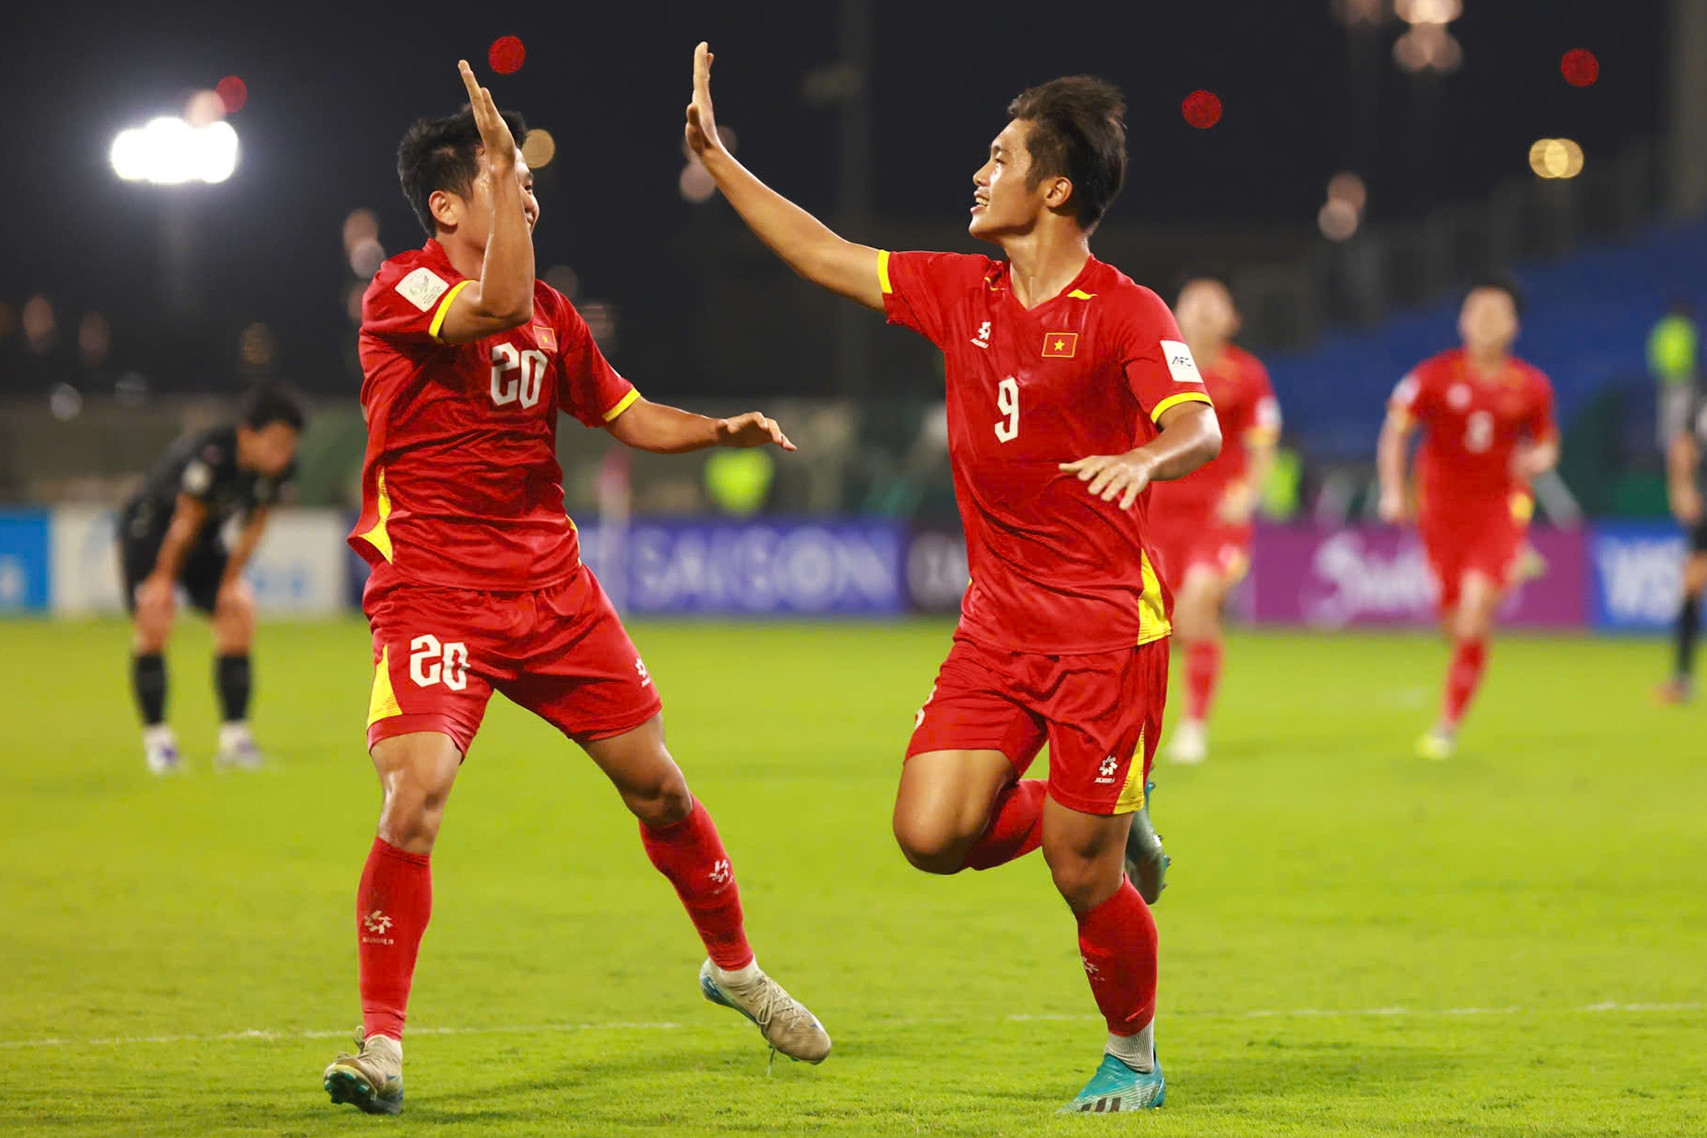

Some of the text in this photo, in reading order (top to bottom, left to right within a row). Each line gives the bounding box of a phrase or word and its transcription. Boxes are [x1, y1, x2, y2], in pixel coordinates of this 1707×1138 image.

[490, 342, 548, 409] 20
[1171, 355, 1193, 367] AFC
[994, 377, 1019, 443] 9
[628, 526, 897, 608] SAISON
[410, 634, 470, 691] 20
